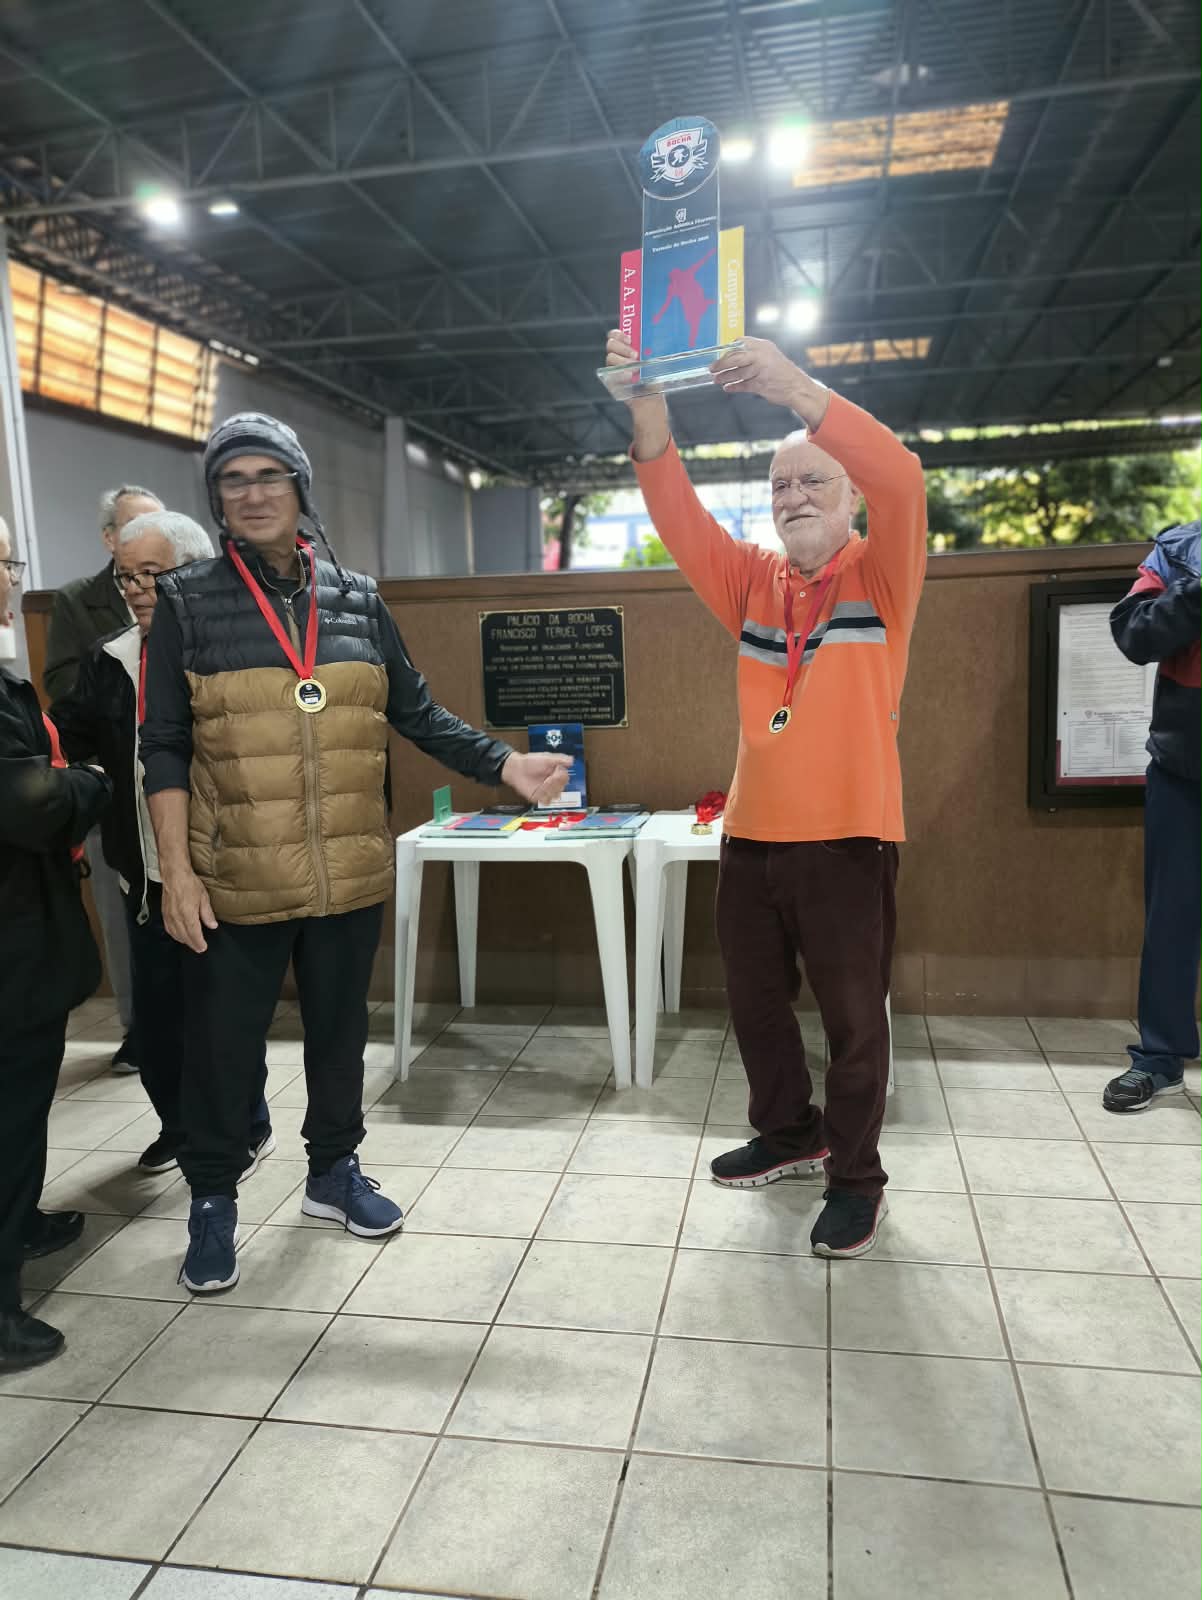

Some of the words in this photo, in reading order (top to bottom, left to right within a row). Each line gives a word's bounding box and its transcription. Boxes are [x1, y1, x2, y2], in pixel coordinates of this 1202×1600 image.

[623, 267, 636, 283] A.
[623, 286, 636, 302] A.
[548, 614, 560, 625] DA
[567, 612, 596, 625] BOCHA
[491, 628, 537, 640] FRANCISCO
[585, 624, 614, 637] LOPES
